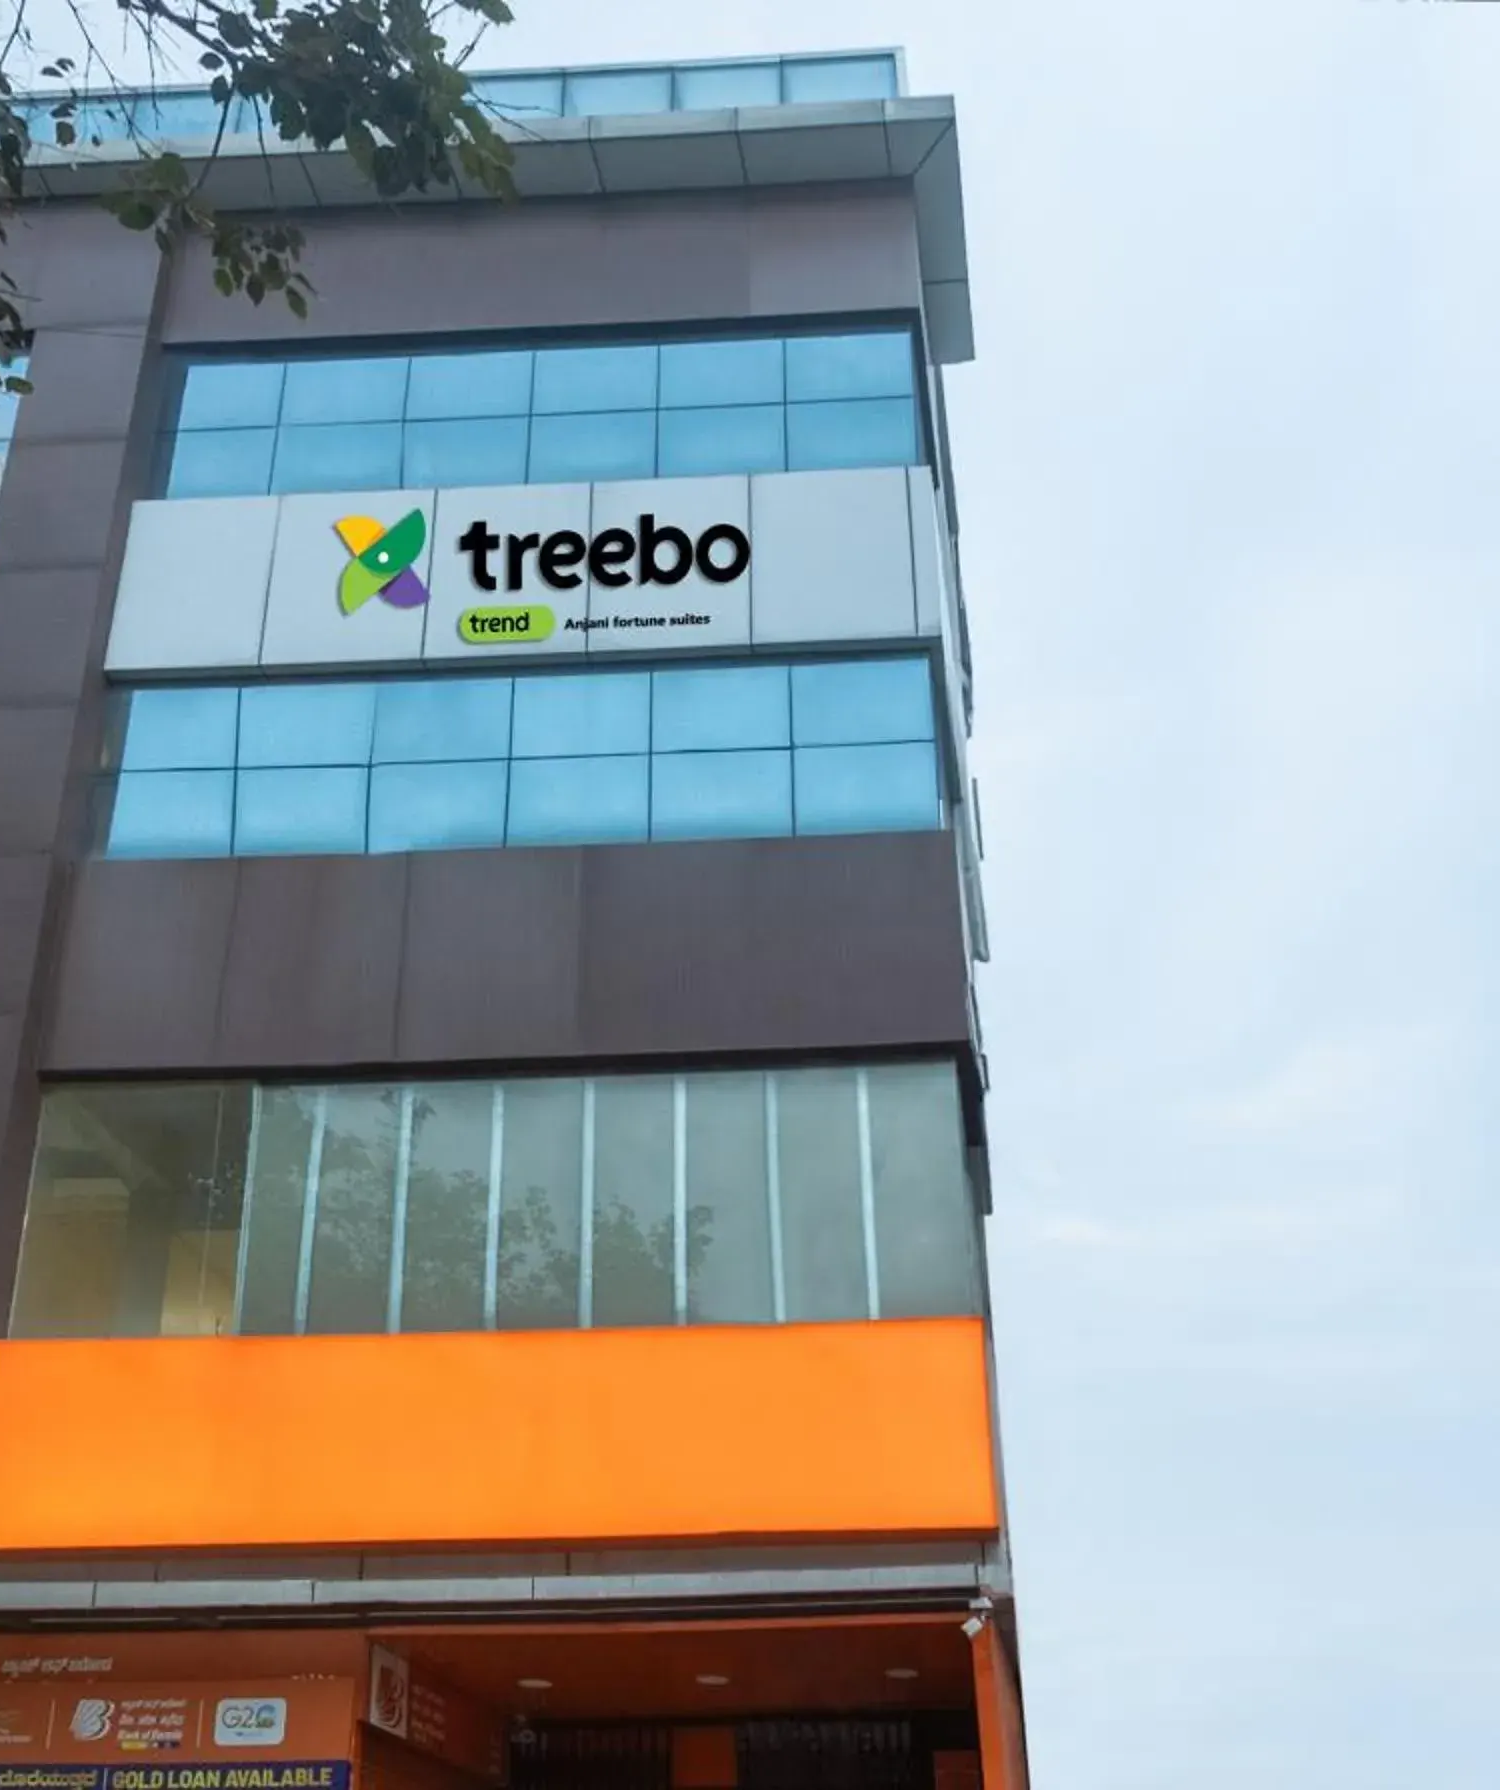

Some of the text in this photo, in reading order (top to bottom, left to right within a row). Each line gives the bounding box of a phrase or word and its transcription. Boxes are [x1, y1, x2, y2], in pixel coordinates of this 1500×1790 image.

[459, 514, 751, 591] treebo
[469, 612, 530, 633] trend
[563, 613, 711, 632] Anjani fortune suites
[112, 1767, 333, 1789] GOLD LOAN AVAILABLE
